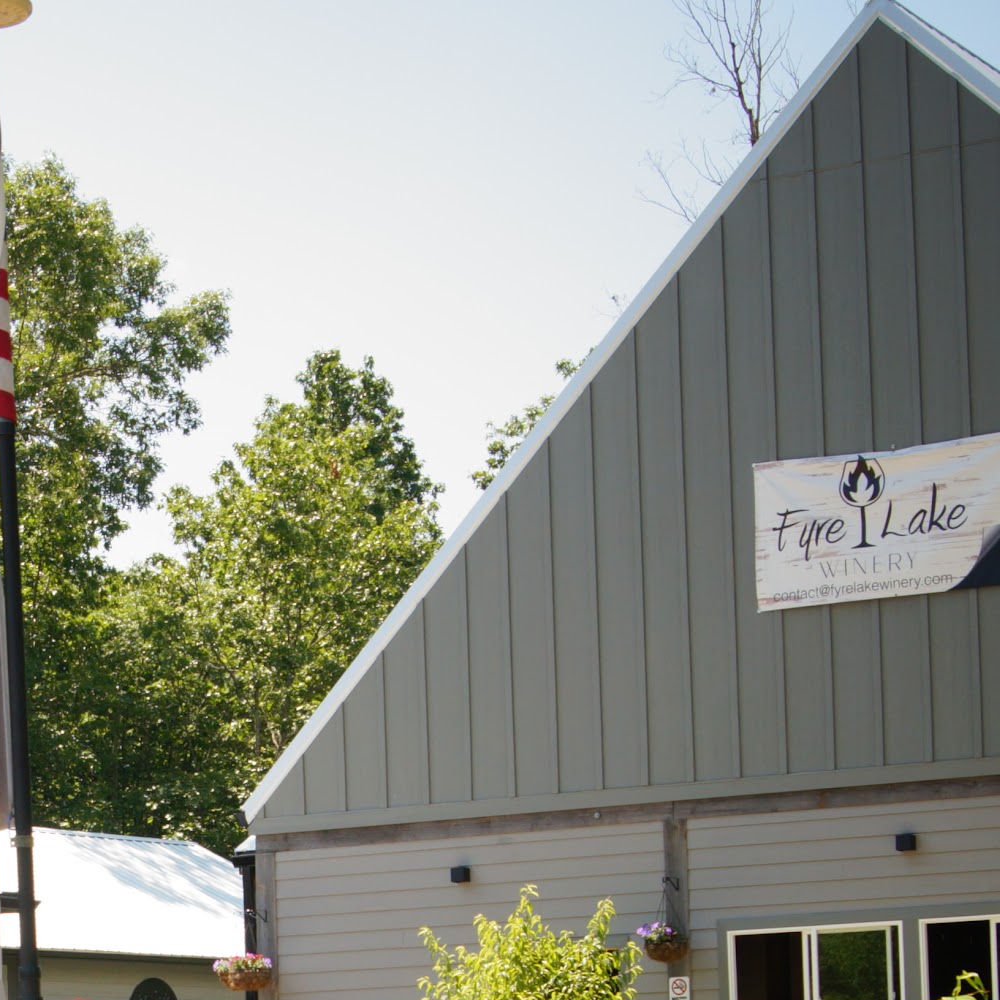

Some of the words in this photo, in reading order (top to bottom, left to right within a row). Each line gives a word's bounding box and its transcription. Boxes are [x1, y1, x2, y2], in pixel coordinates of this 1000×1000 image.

[772, 508, 848, 562] Fyre
[881, 482, 968, 539] Lake
[818, 551, 920, 579] WINERY
[773, 573, 954, 603] contact@fyrelakewinery.com
